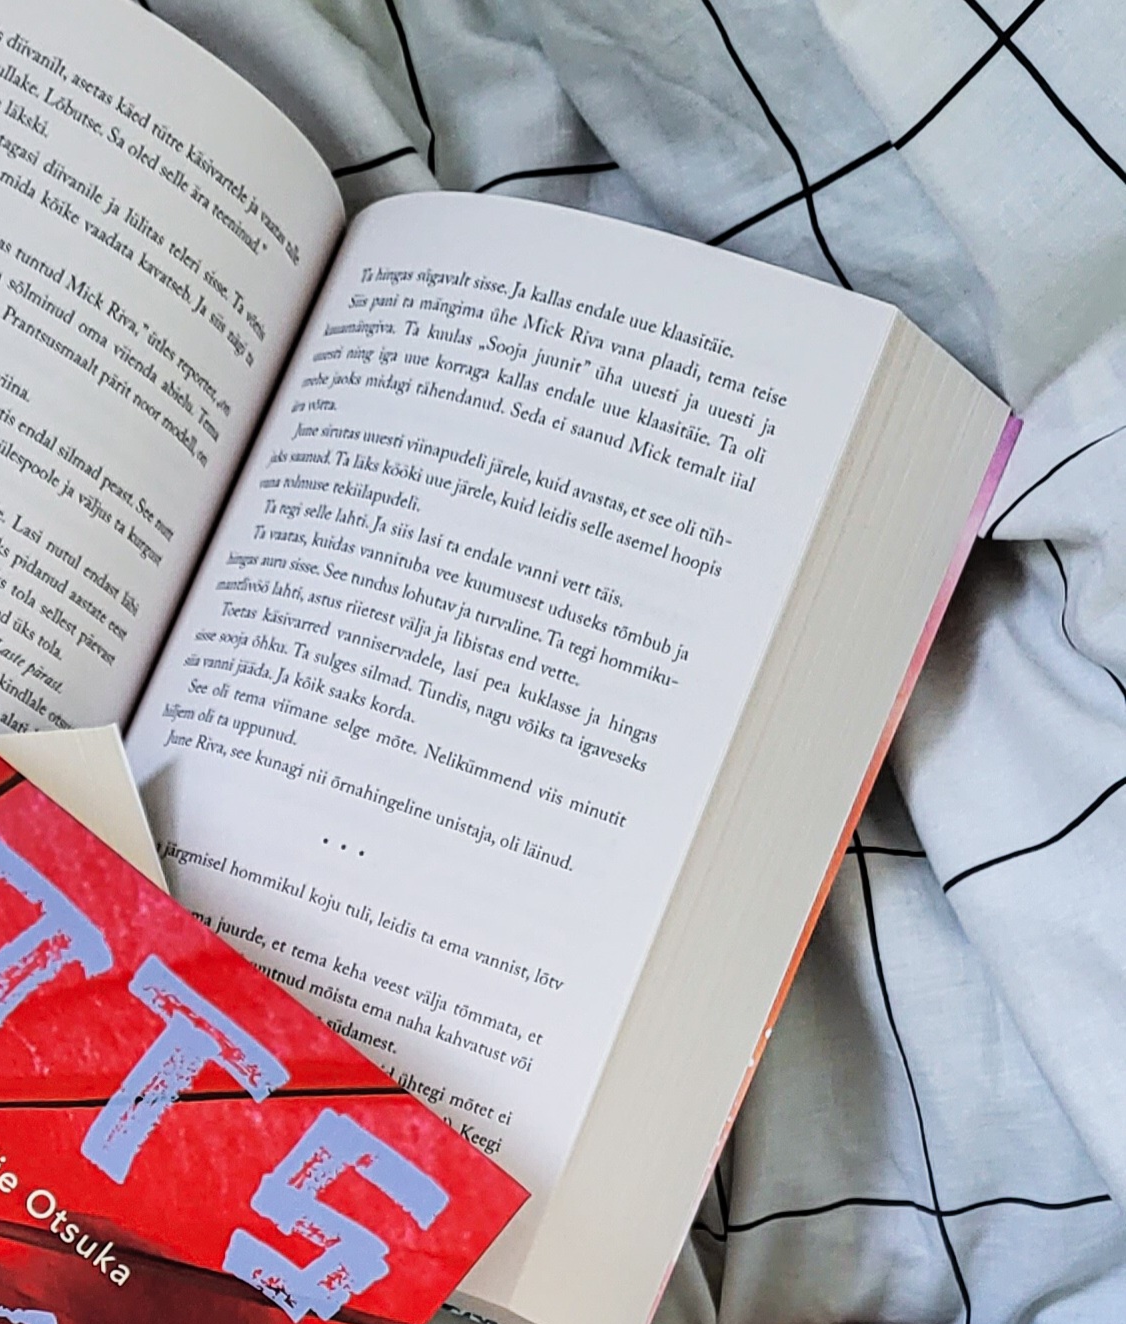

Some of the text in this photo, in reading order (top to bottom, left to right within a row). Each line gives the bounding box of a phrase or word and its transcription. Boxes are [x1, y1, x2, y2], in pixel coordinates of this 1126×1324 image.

[4, 100, 48, 138] läkski.
[369, 294, 399, 312] pani
[402, 297, 414, 308] ta
[420, 298, 484, 319] mängima
[490, 308, 518, 326] ühe
[523, 313, 565, 338] Mick
[570, 325, 604, 349] Riva
[611, 342, 645, 362] vana
[649, 352, 701, 382] plaadi,
[708, 371, 745, 394] tema
[752, 386, 787, 407] teise
[163, 729, 573, 871] June Riva, see kunagi nii õrnahingeline unistaja, oli läinud.
[229, 860, 306, 899] hommikul
[308, 887, 341, 912] koju
[346, 904, 373, 926] tuli,
[377, 911, 416, 938] leidis
[421, 931, 434, 945] ta
[439, 939, 469, 958] ema
[475, 951, 530, 982] vannist,
[534, 968, 564, 990] lõtv
[26, 1189, 131, 1286] Otsuka
